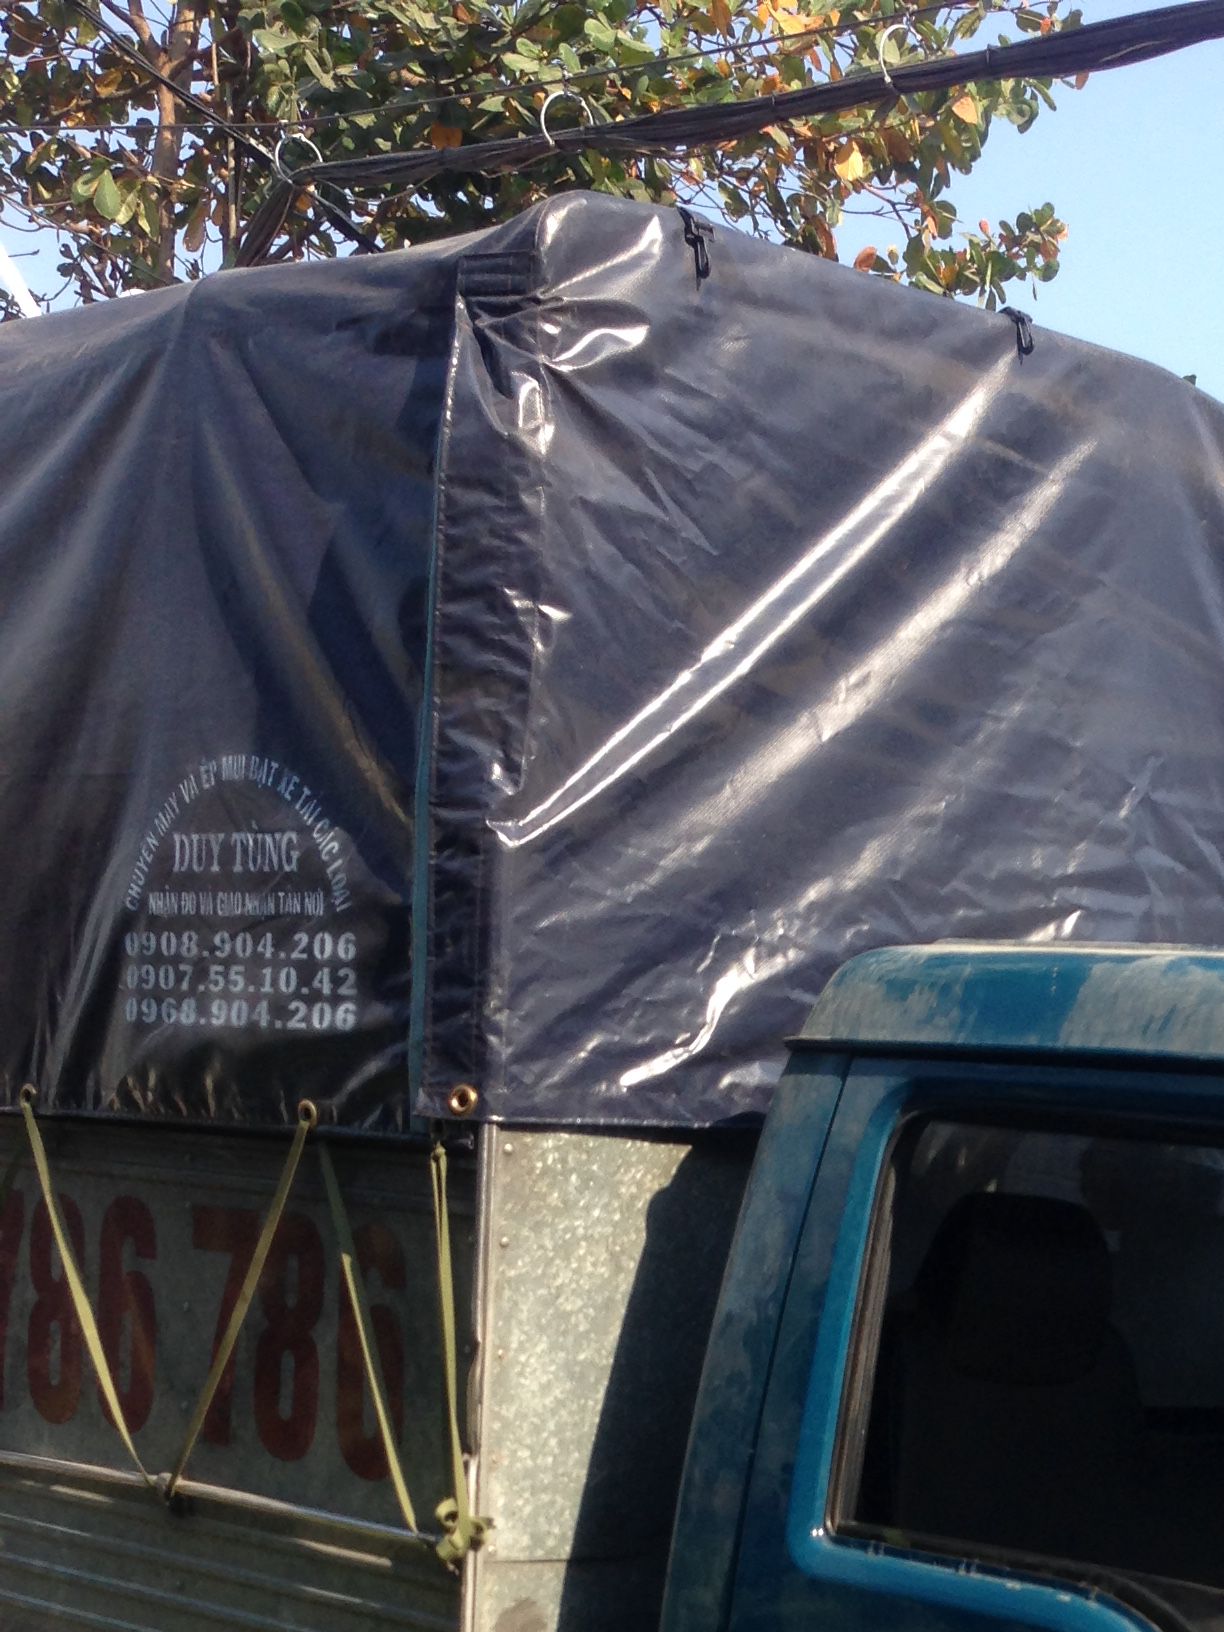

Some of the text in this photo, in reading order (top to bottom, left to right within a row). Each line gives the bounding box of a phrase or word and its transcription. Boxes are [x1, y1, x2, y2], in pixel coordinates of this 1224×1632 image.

[172, 820, 300, 873] DUY TÙNG
[125, 931, 357, 960] 0908.904.206
[126, 964, 358, 996] 0907.55.10.42
[125, 998, 358, 1031] 0968.904.206
